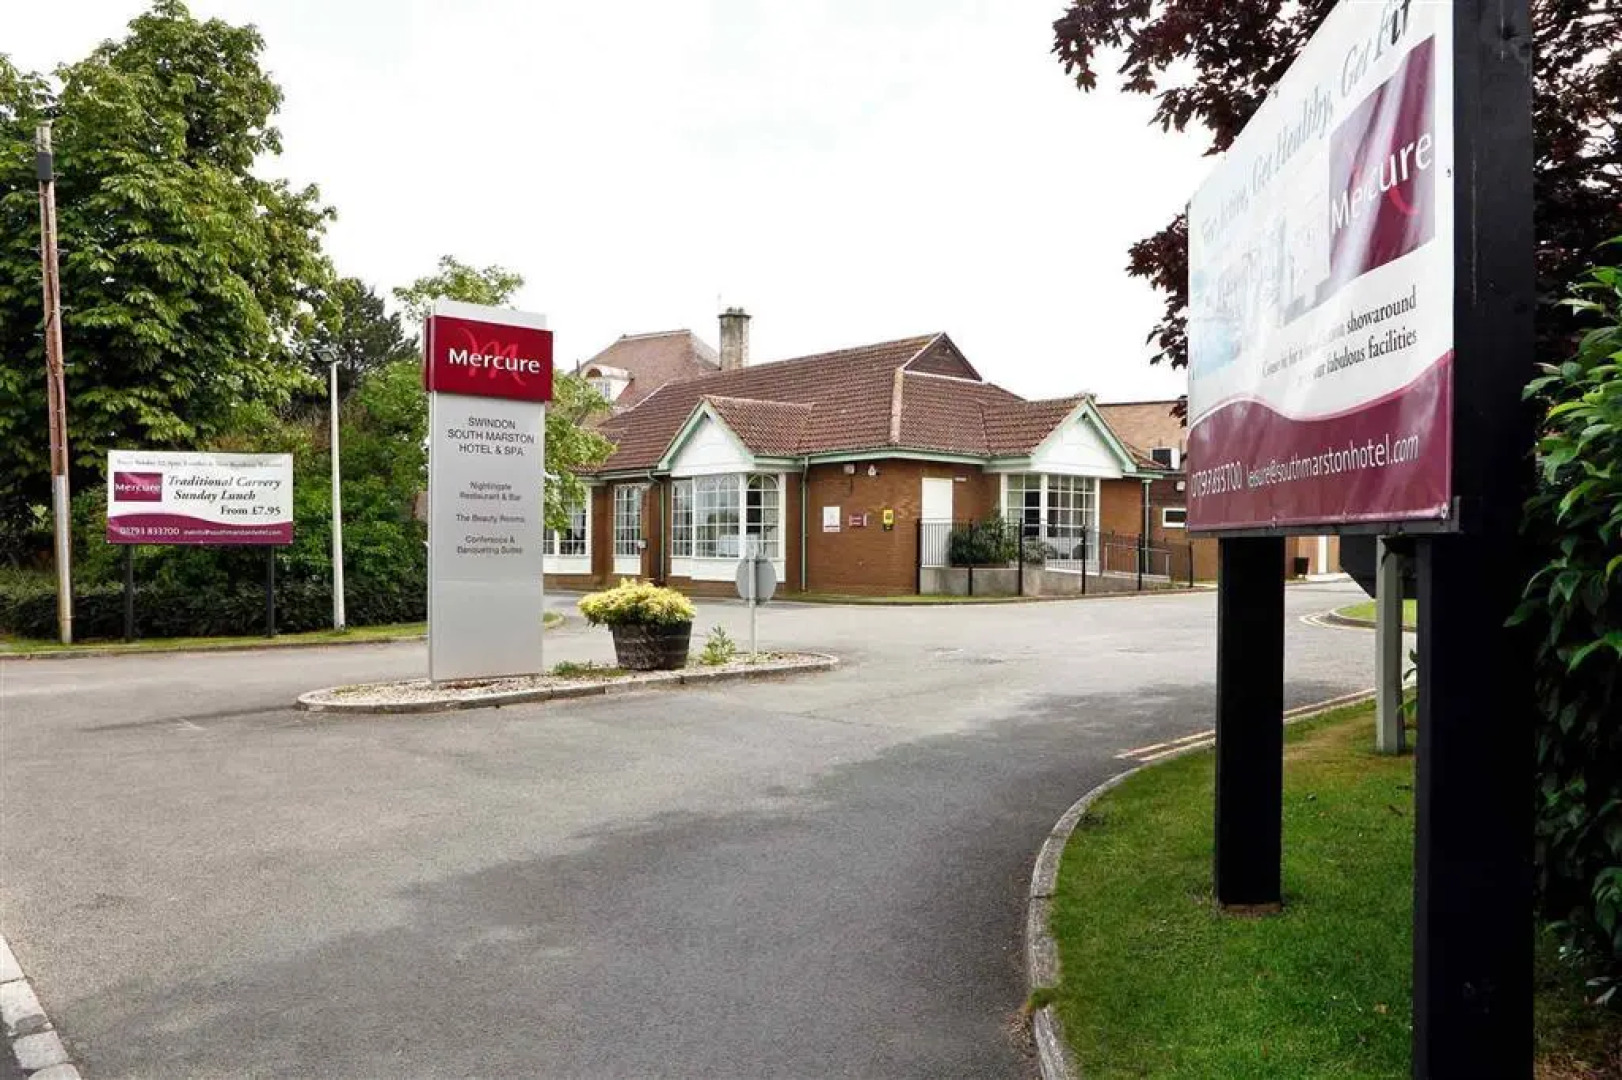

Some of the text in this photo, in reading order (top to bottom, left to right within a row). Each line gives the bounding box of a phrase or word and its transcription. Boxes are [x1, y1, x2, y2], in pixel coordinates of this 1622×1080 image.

[1331, 132, 1431, 235] Mercure
[1346, 284, 1417, 335] showaround
[1326, 346, 1366, 375] fabulous
[1368, 325, 1417, 359] facilities
[448, 347, 540, 373] Mercure
[468, 416, 516, 429] SWINDON
[447, 428, 535, 444] SOUTH MARSTON
[459, 443, 524, 456] HOTEL & SPA
[168, 474, 234, 487] Traditional
[114, 483, 161, 495] Mercure
[173, 489, 256, 504] Sunday Lunch
[220, 505, 281, 516] From £7.95
